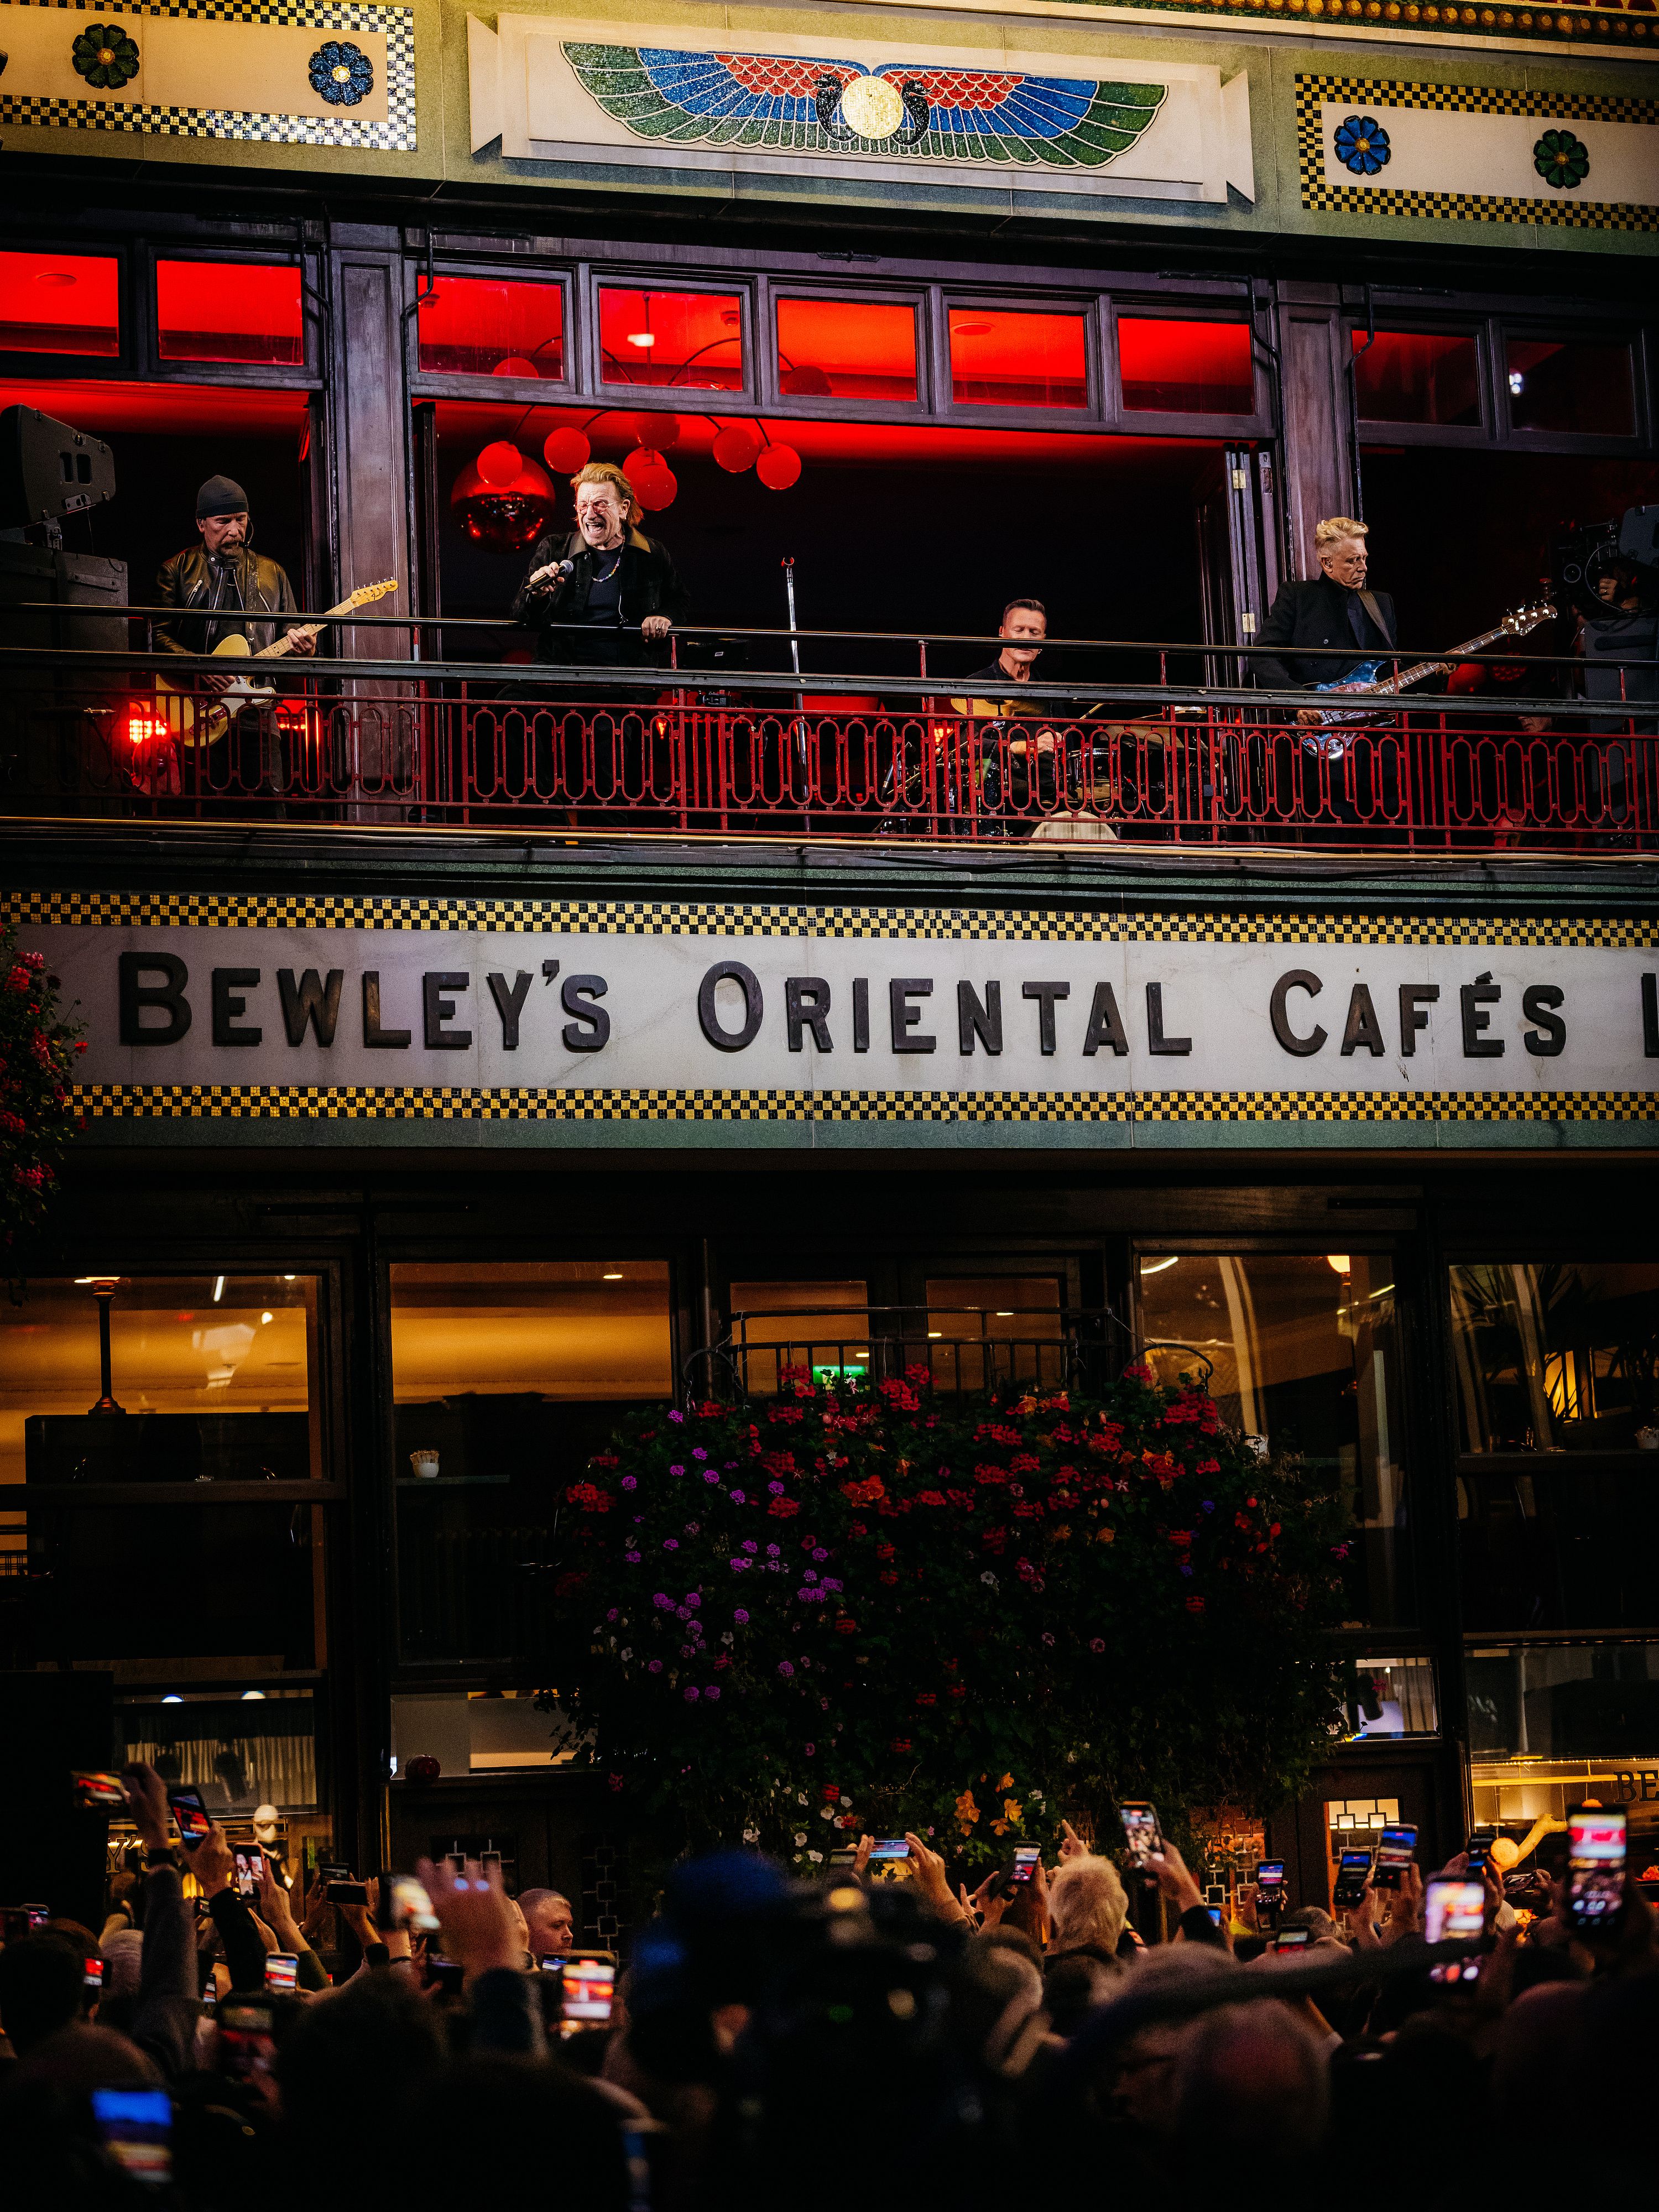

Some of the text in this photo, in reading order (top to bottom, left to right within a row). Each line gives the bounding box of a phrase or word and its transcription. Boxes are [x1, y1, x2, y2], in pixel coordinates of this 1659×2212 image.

[119, 951, 610, 1053] BEWLEY'S
[698, 960, 1192, 1056] ORIENTAL
[1270, 969, 1567, 1058] CAFÉS
[1613, 1770, 1659, 1803] BE
